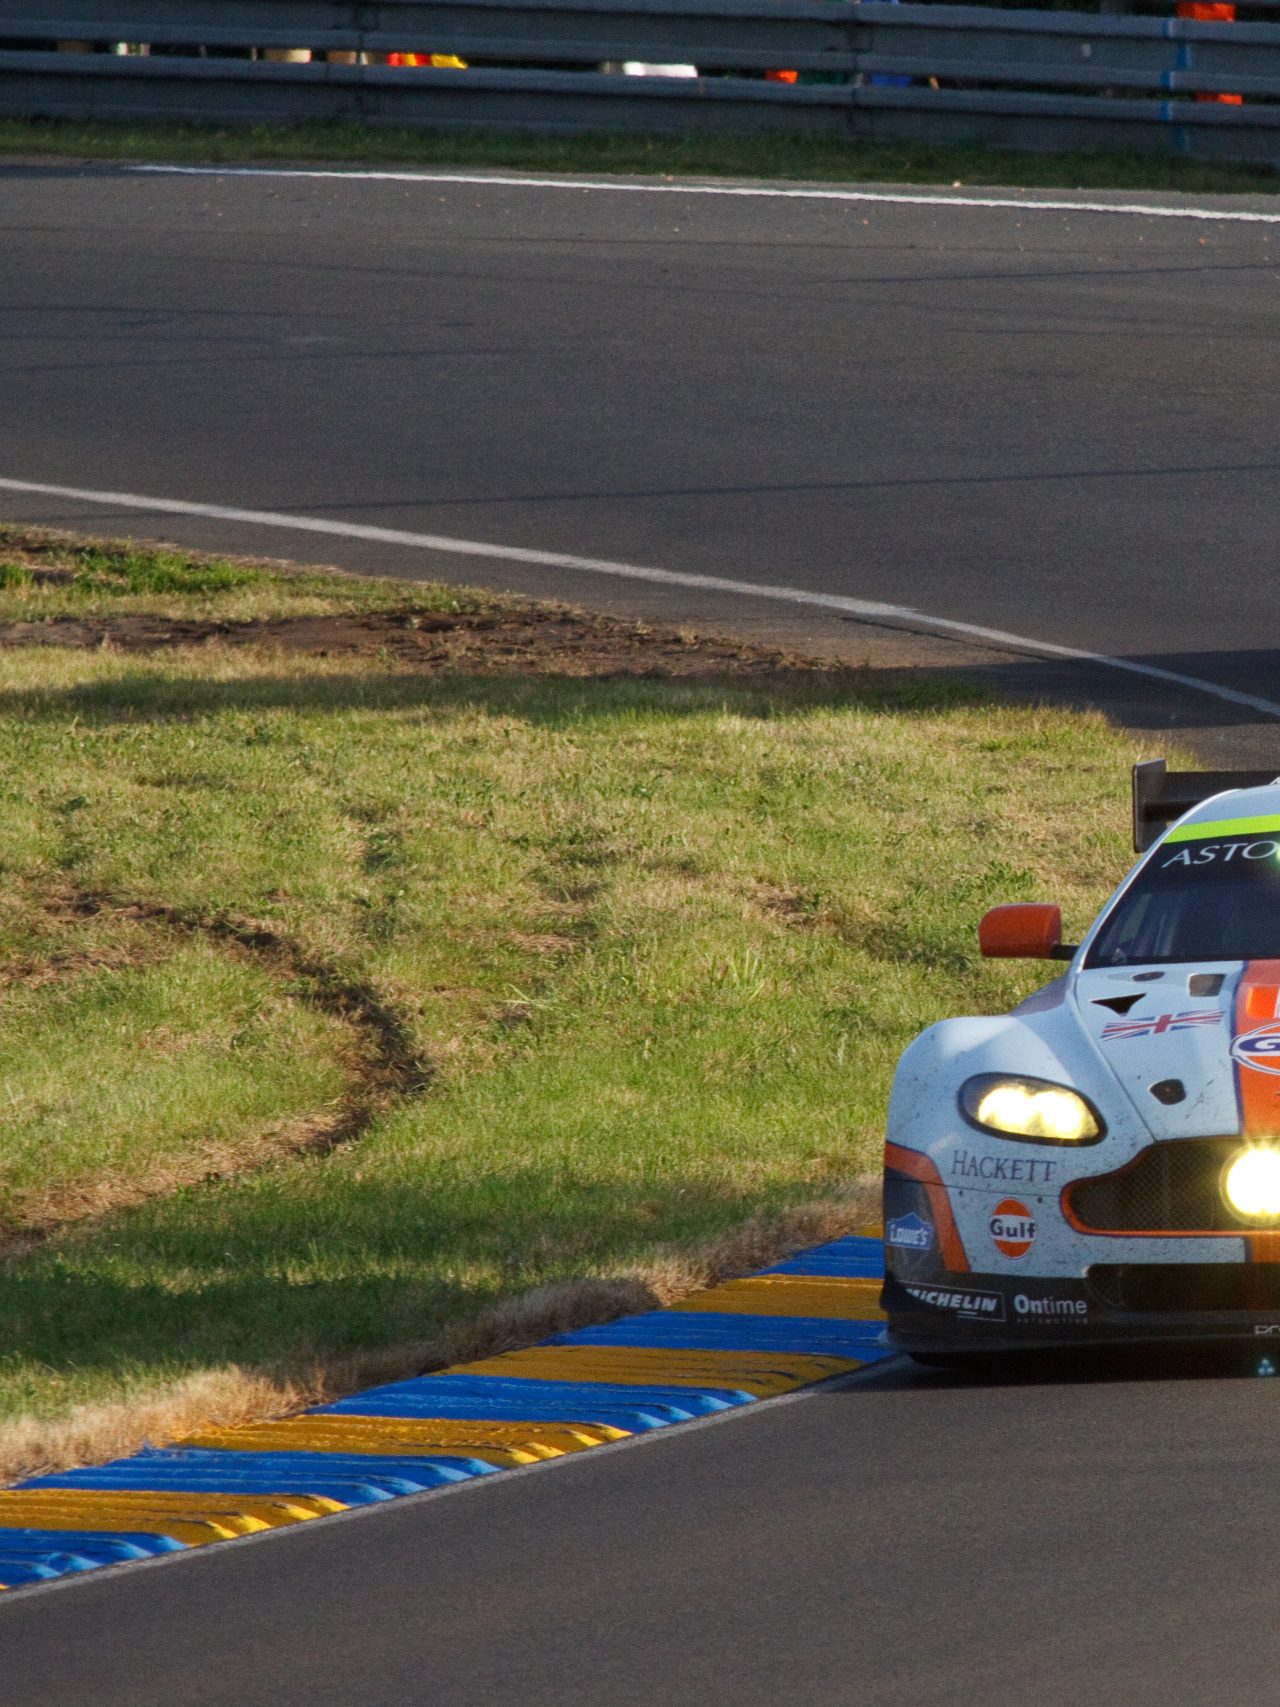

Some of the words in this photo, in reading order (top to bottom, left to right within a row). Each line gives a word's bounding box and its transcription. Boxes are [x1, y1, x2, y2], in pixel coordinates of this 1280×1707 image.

[951, 1150, 1057, 1182] HACKETT
[990, 1218, 1036, 1239] Gulf
[1014, 1293, 1088, 1314] Ontime
